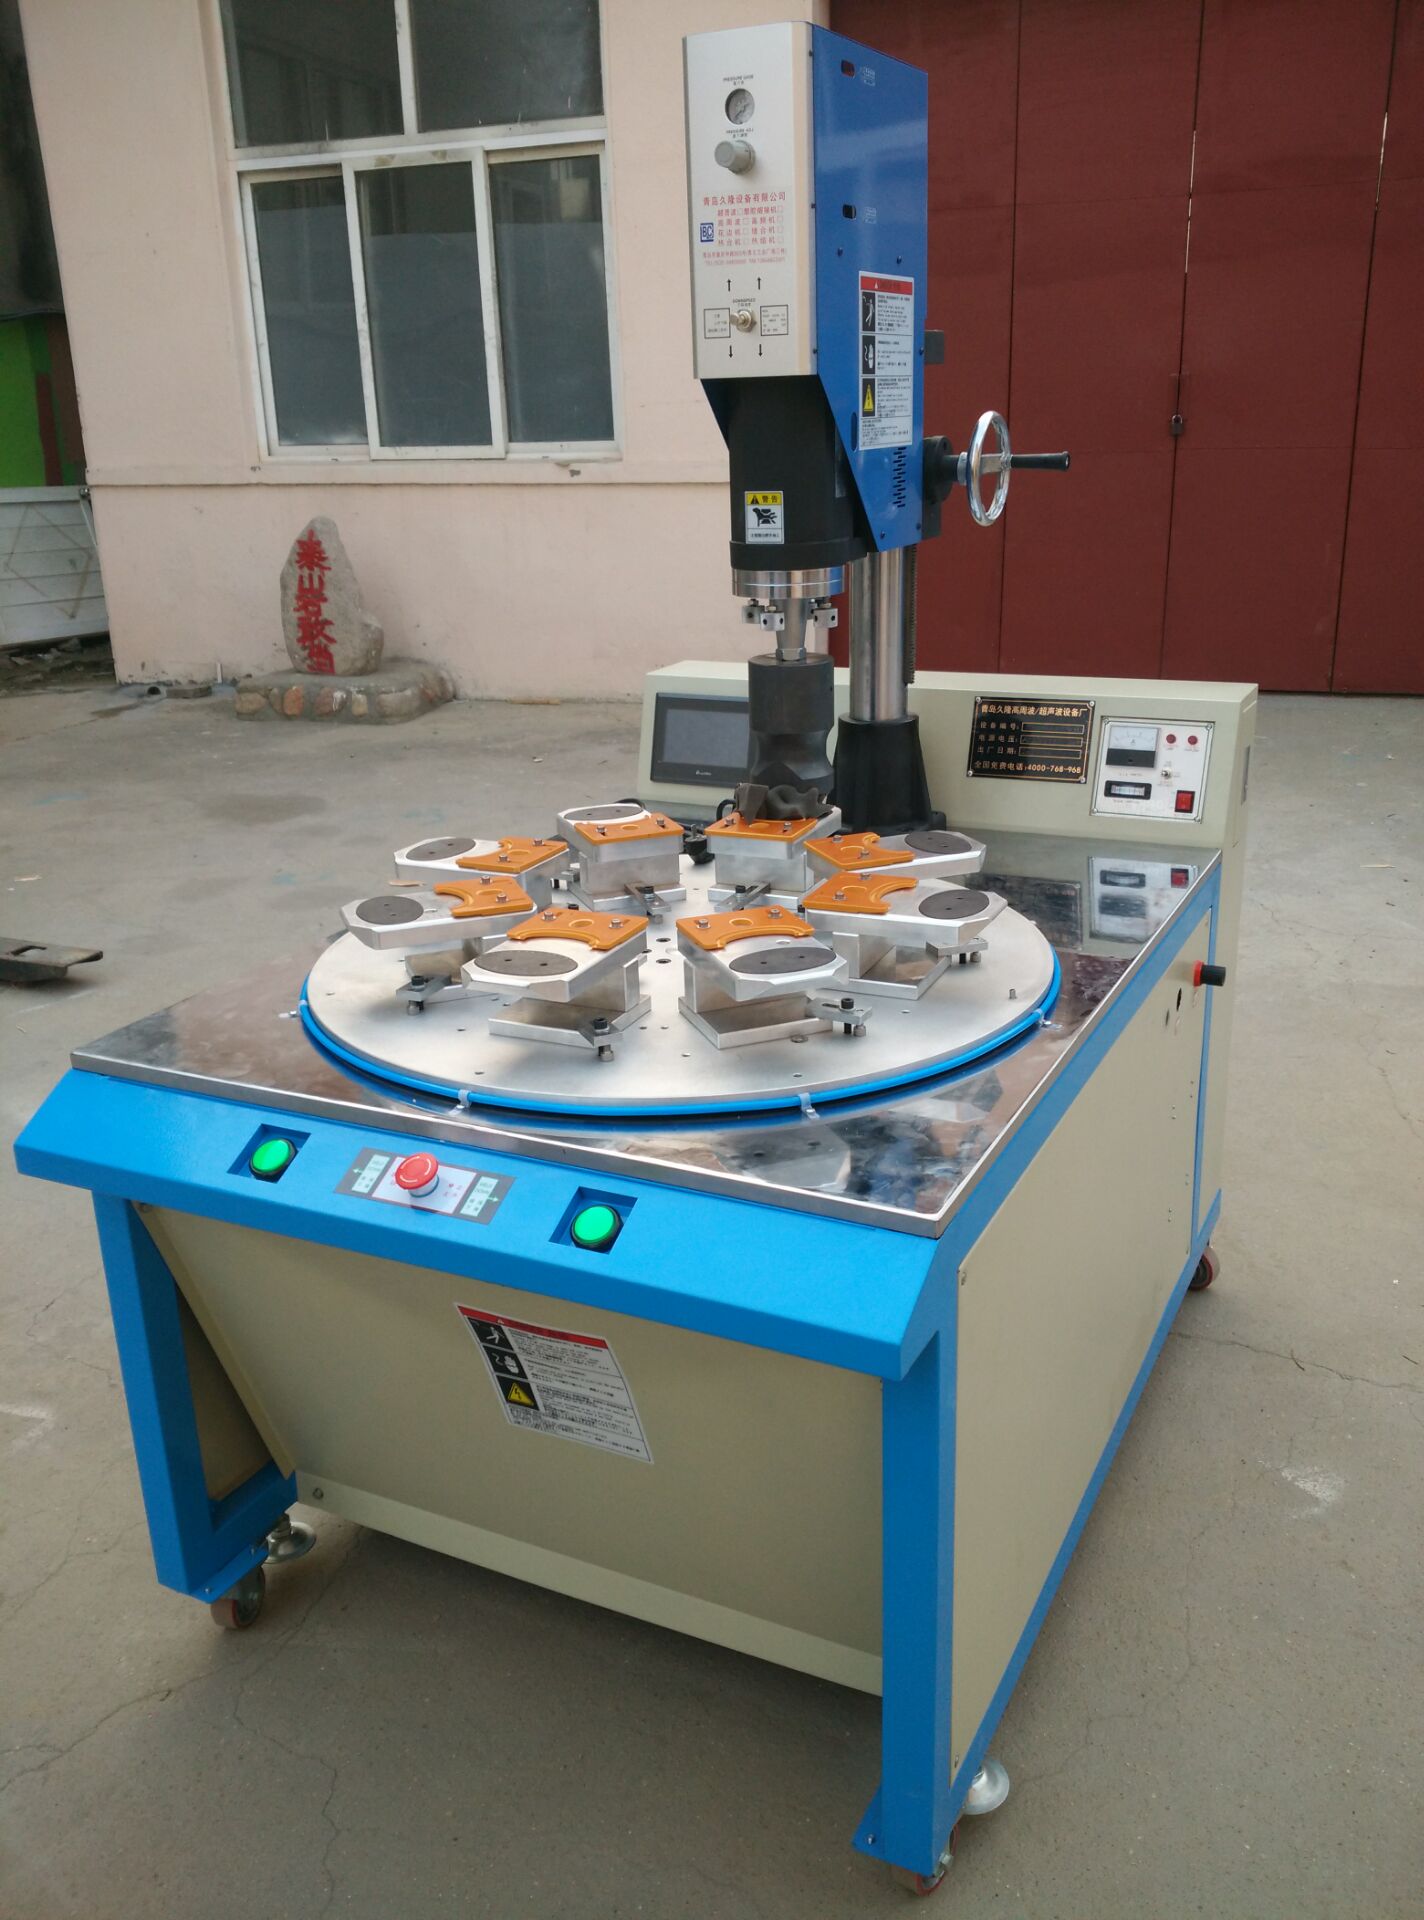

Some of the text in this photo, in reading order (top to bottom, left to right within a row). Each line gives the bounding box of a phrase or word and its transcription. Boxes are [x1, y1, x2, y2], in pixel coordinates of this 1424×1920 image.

[703, 191, 786, 206] 青岛久隆设备有限公司
[762, 495, 777, 503] 警告
[981, 704, 1088, 717] 青岛久隆高周波/超声波设备厂
